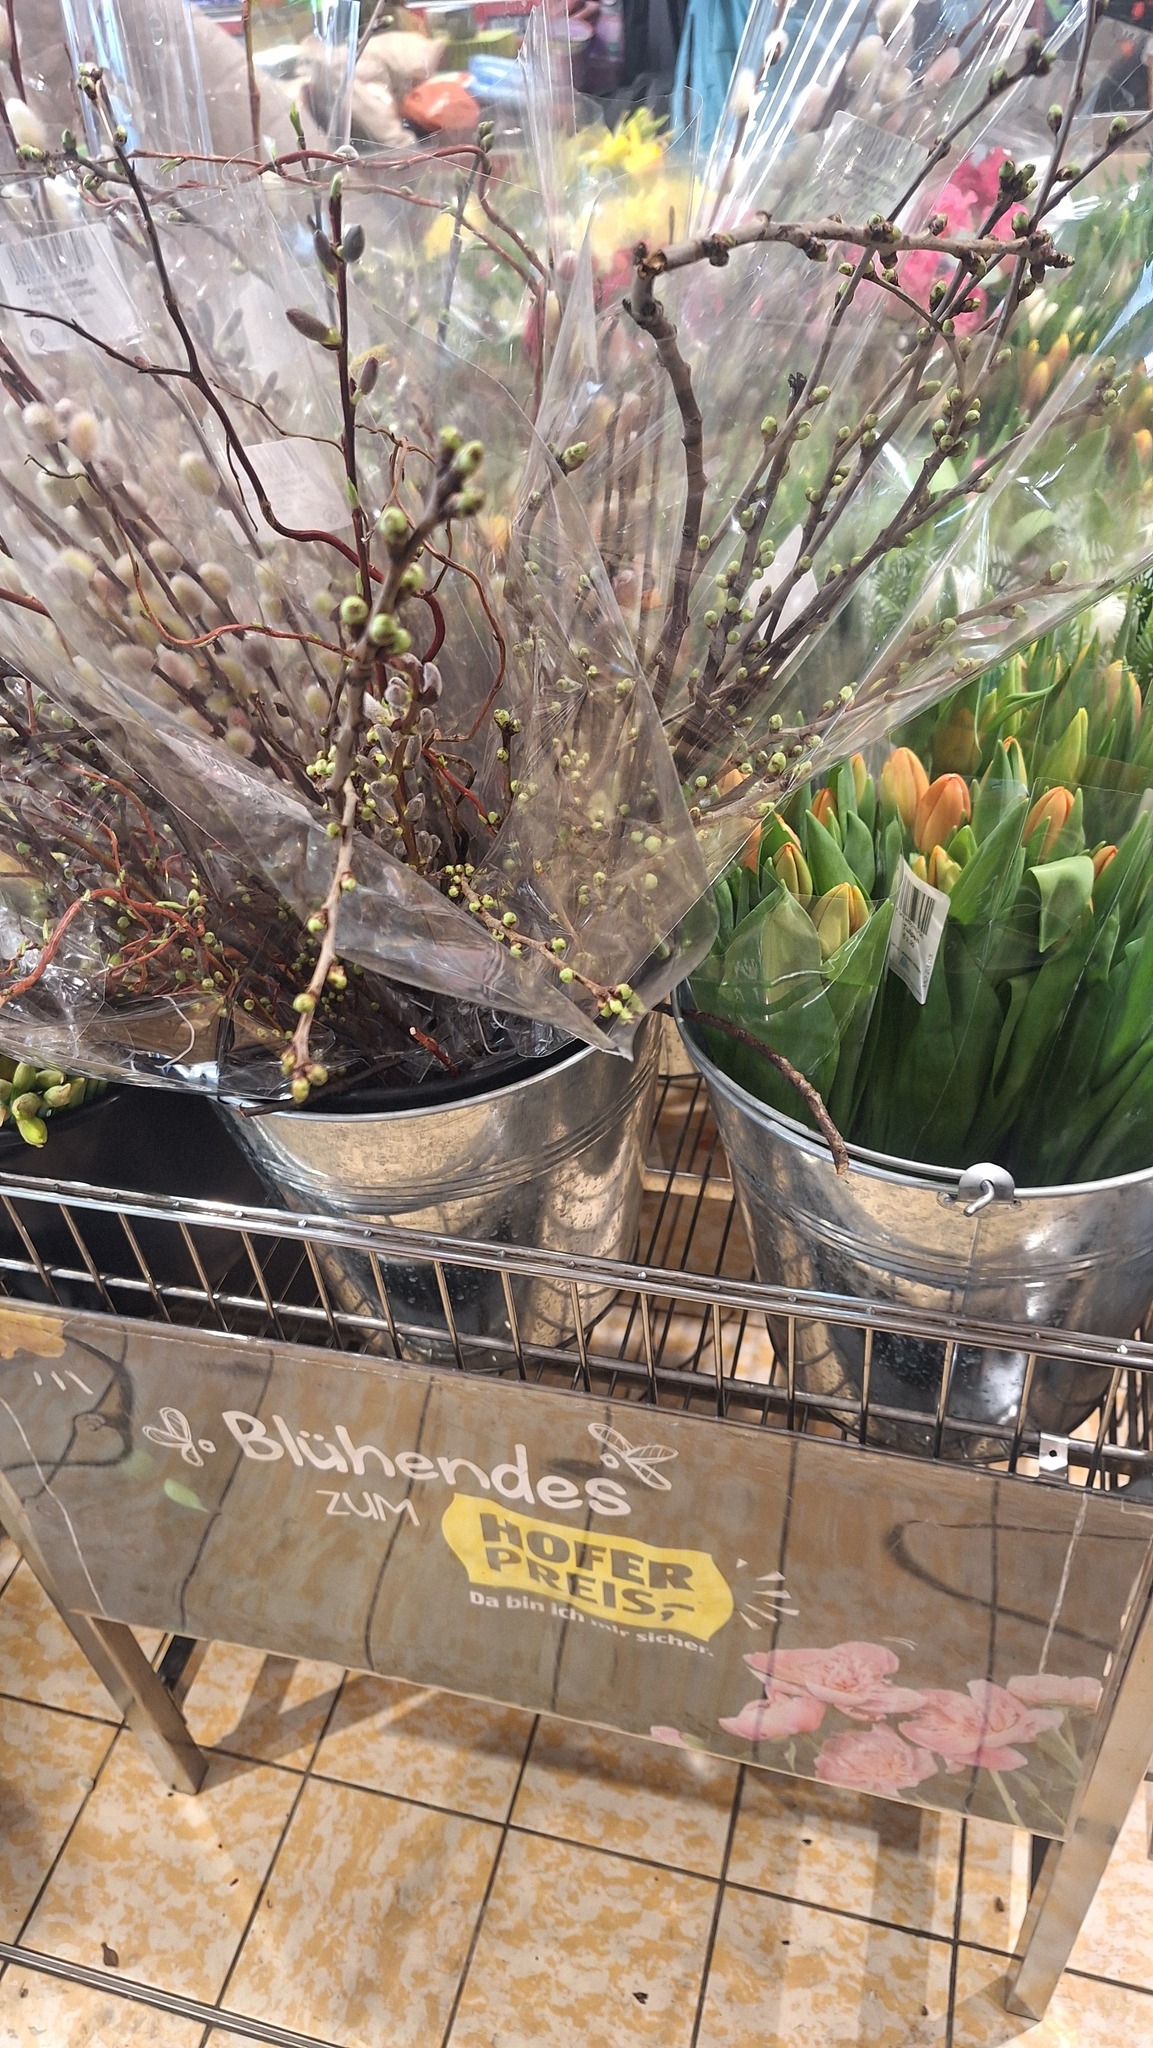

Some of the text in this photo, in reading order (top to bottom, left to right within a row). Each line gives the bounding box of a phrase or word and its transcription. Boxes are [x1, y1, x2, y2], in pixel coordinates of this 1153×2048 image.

[221, 1410, 632, 1516] Blühendes
[479, 1512, 695, 1592] HOFER
[469, 1590, 500, 1608] Da
[505, 1595, 545, 1612] bin
[551, 1601, 585, 1623] ich
